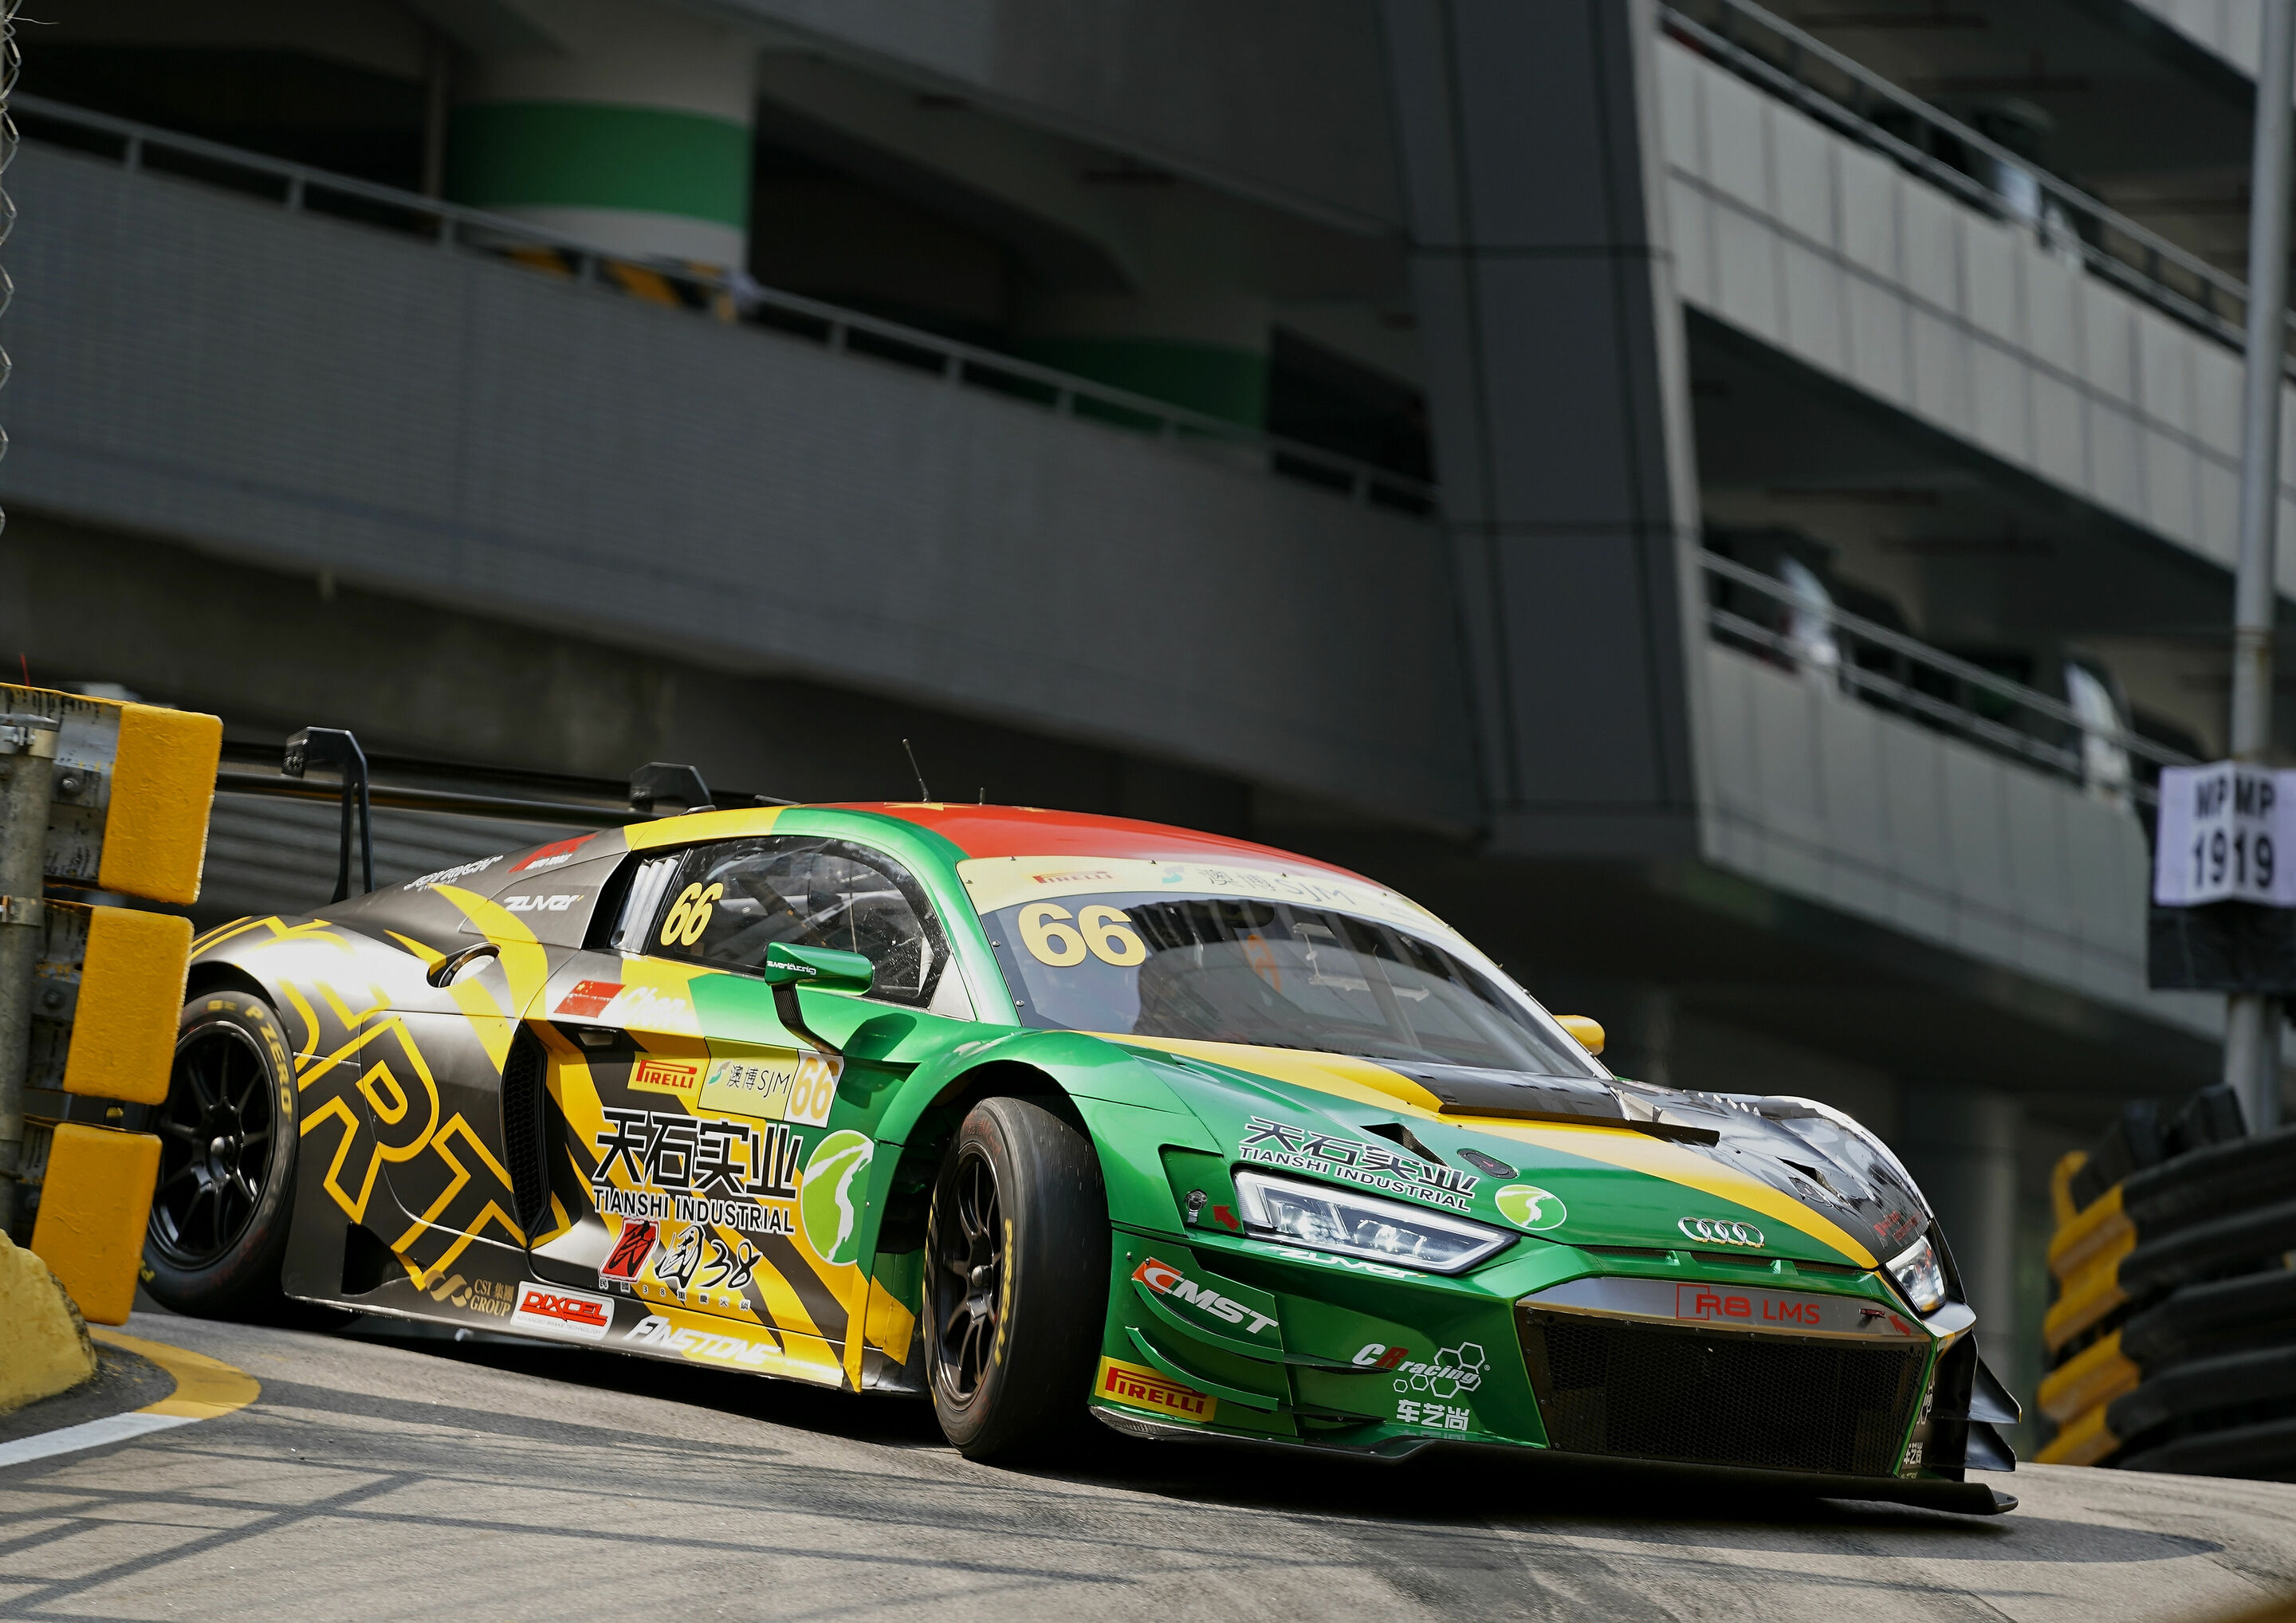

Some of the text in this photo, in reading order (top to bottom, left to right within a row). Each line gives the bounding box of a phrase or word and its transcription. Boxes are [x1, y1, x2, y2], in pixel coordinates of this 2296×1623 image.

[660, 882, 724, 947] 66
[1018, 902, 1146, 967] 66
[245, 1004, 265, 1020] P
[260, 1022, 293, 1114] ZERO
[635, 1059, 698, 1089] PIRELLI
[791, 1058, 841, 1119] 66
[592, 1106, 804, 1199] 天石实业
[1240, 1114, 1482, 1199] 天石实业
[1239, 1146, 1472, 1212] TIANSHI INDUSTRIAL
[593, 1185, 796, 1235] TIANSHI INDUSTRIAL
[469, 1295, 512, 1317] GROUP
[474, 1279, 493, 1297] CSI
[519, 1290, 608, 1327] DIXCEL
[1143, 1267, 1280, 1335] CMST
[1696, 1293, 1821, 1325] R8 LMS
[1105, 1366, 1205, 1414] PIRELLI
[1397, 1360, 1480, 1385] racing
[1396, 1399, 1470, 1431] 车艺尚
